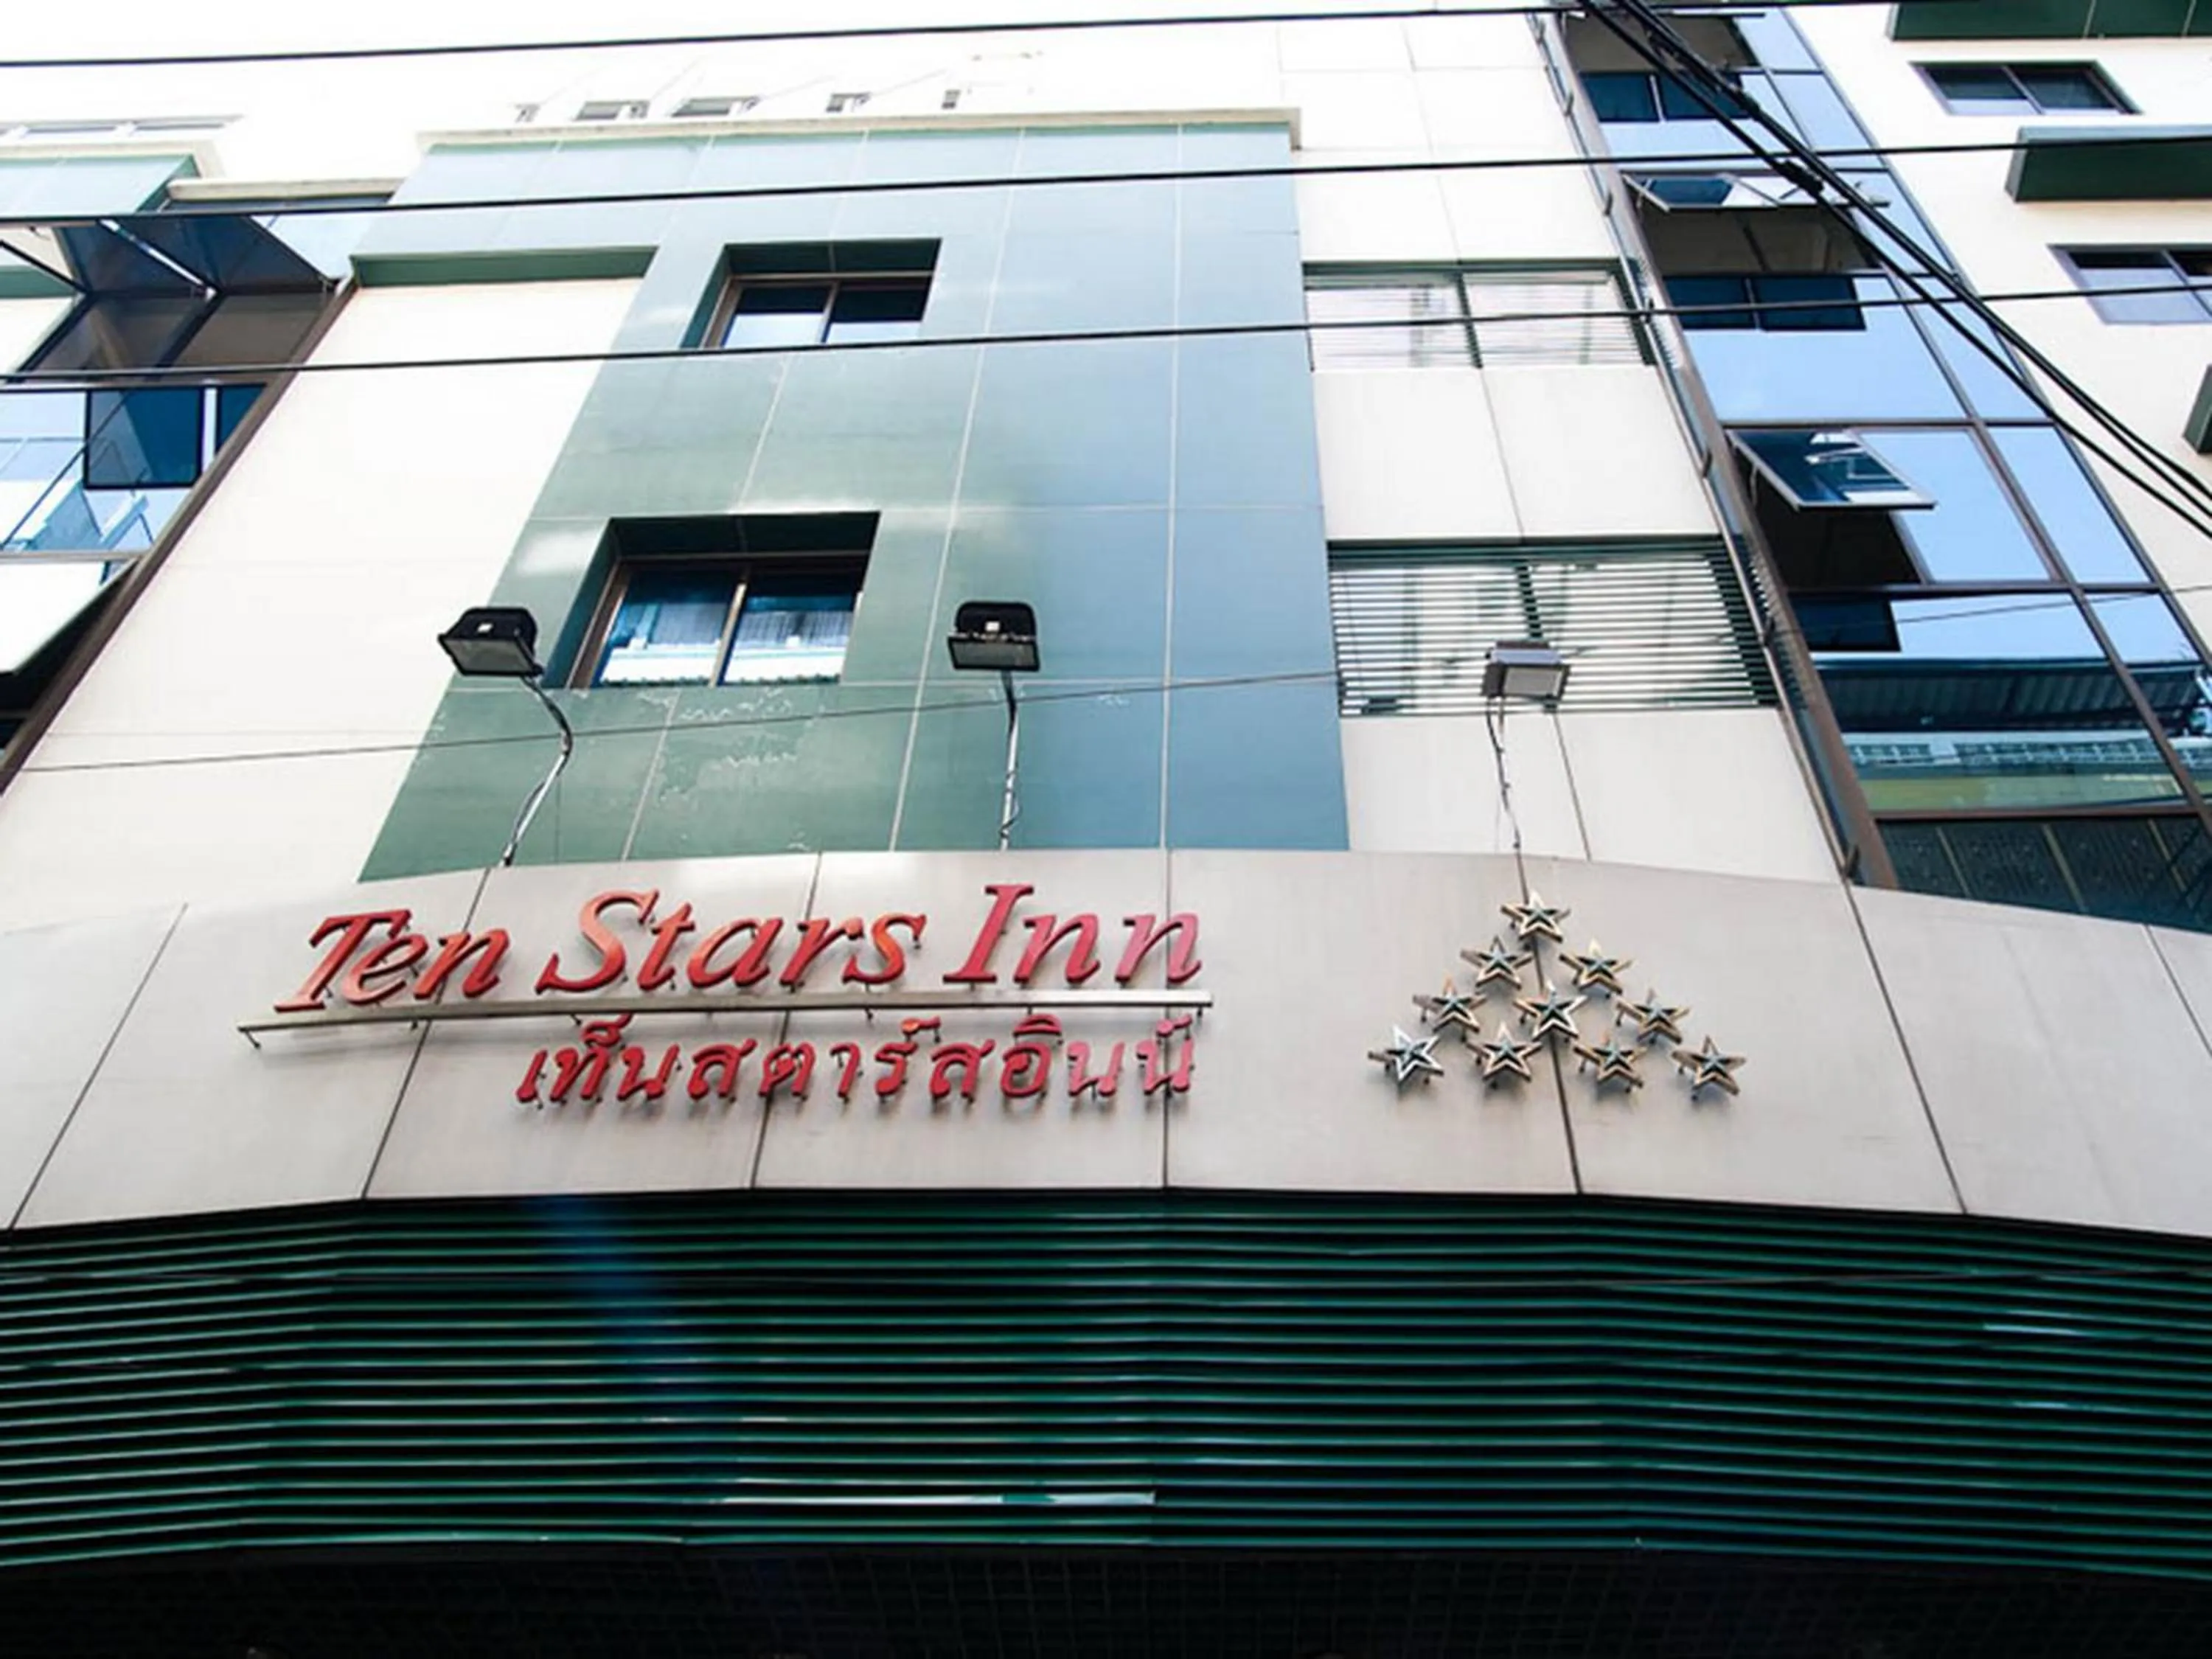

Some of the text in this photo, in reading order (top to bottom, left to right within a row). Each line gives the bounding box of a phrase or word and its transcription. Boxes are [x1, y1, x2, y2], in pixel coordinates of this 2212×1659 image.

[274, 884, 1202, 1013] Ten Stars Inn
[515, 1013, 1196, 1103] เท็นสตาร์สอินน์
